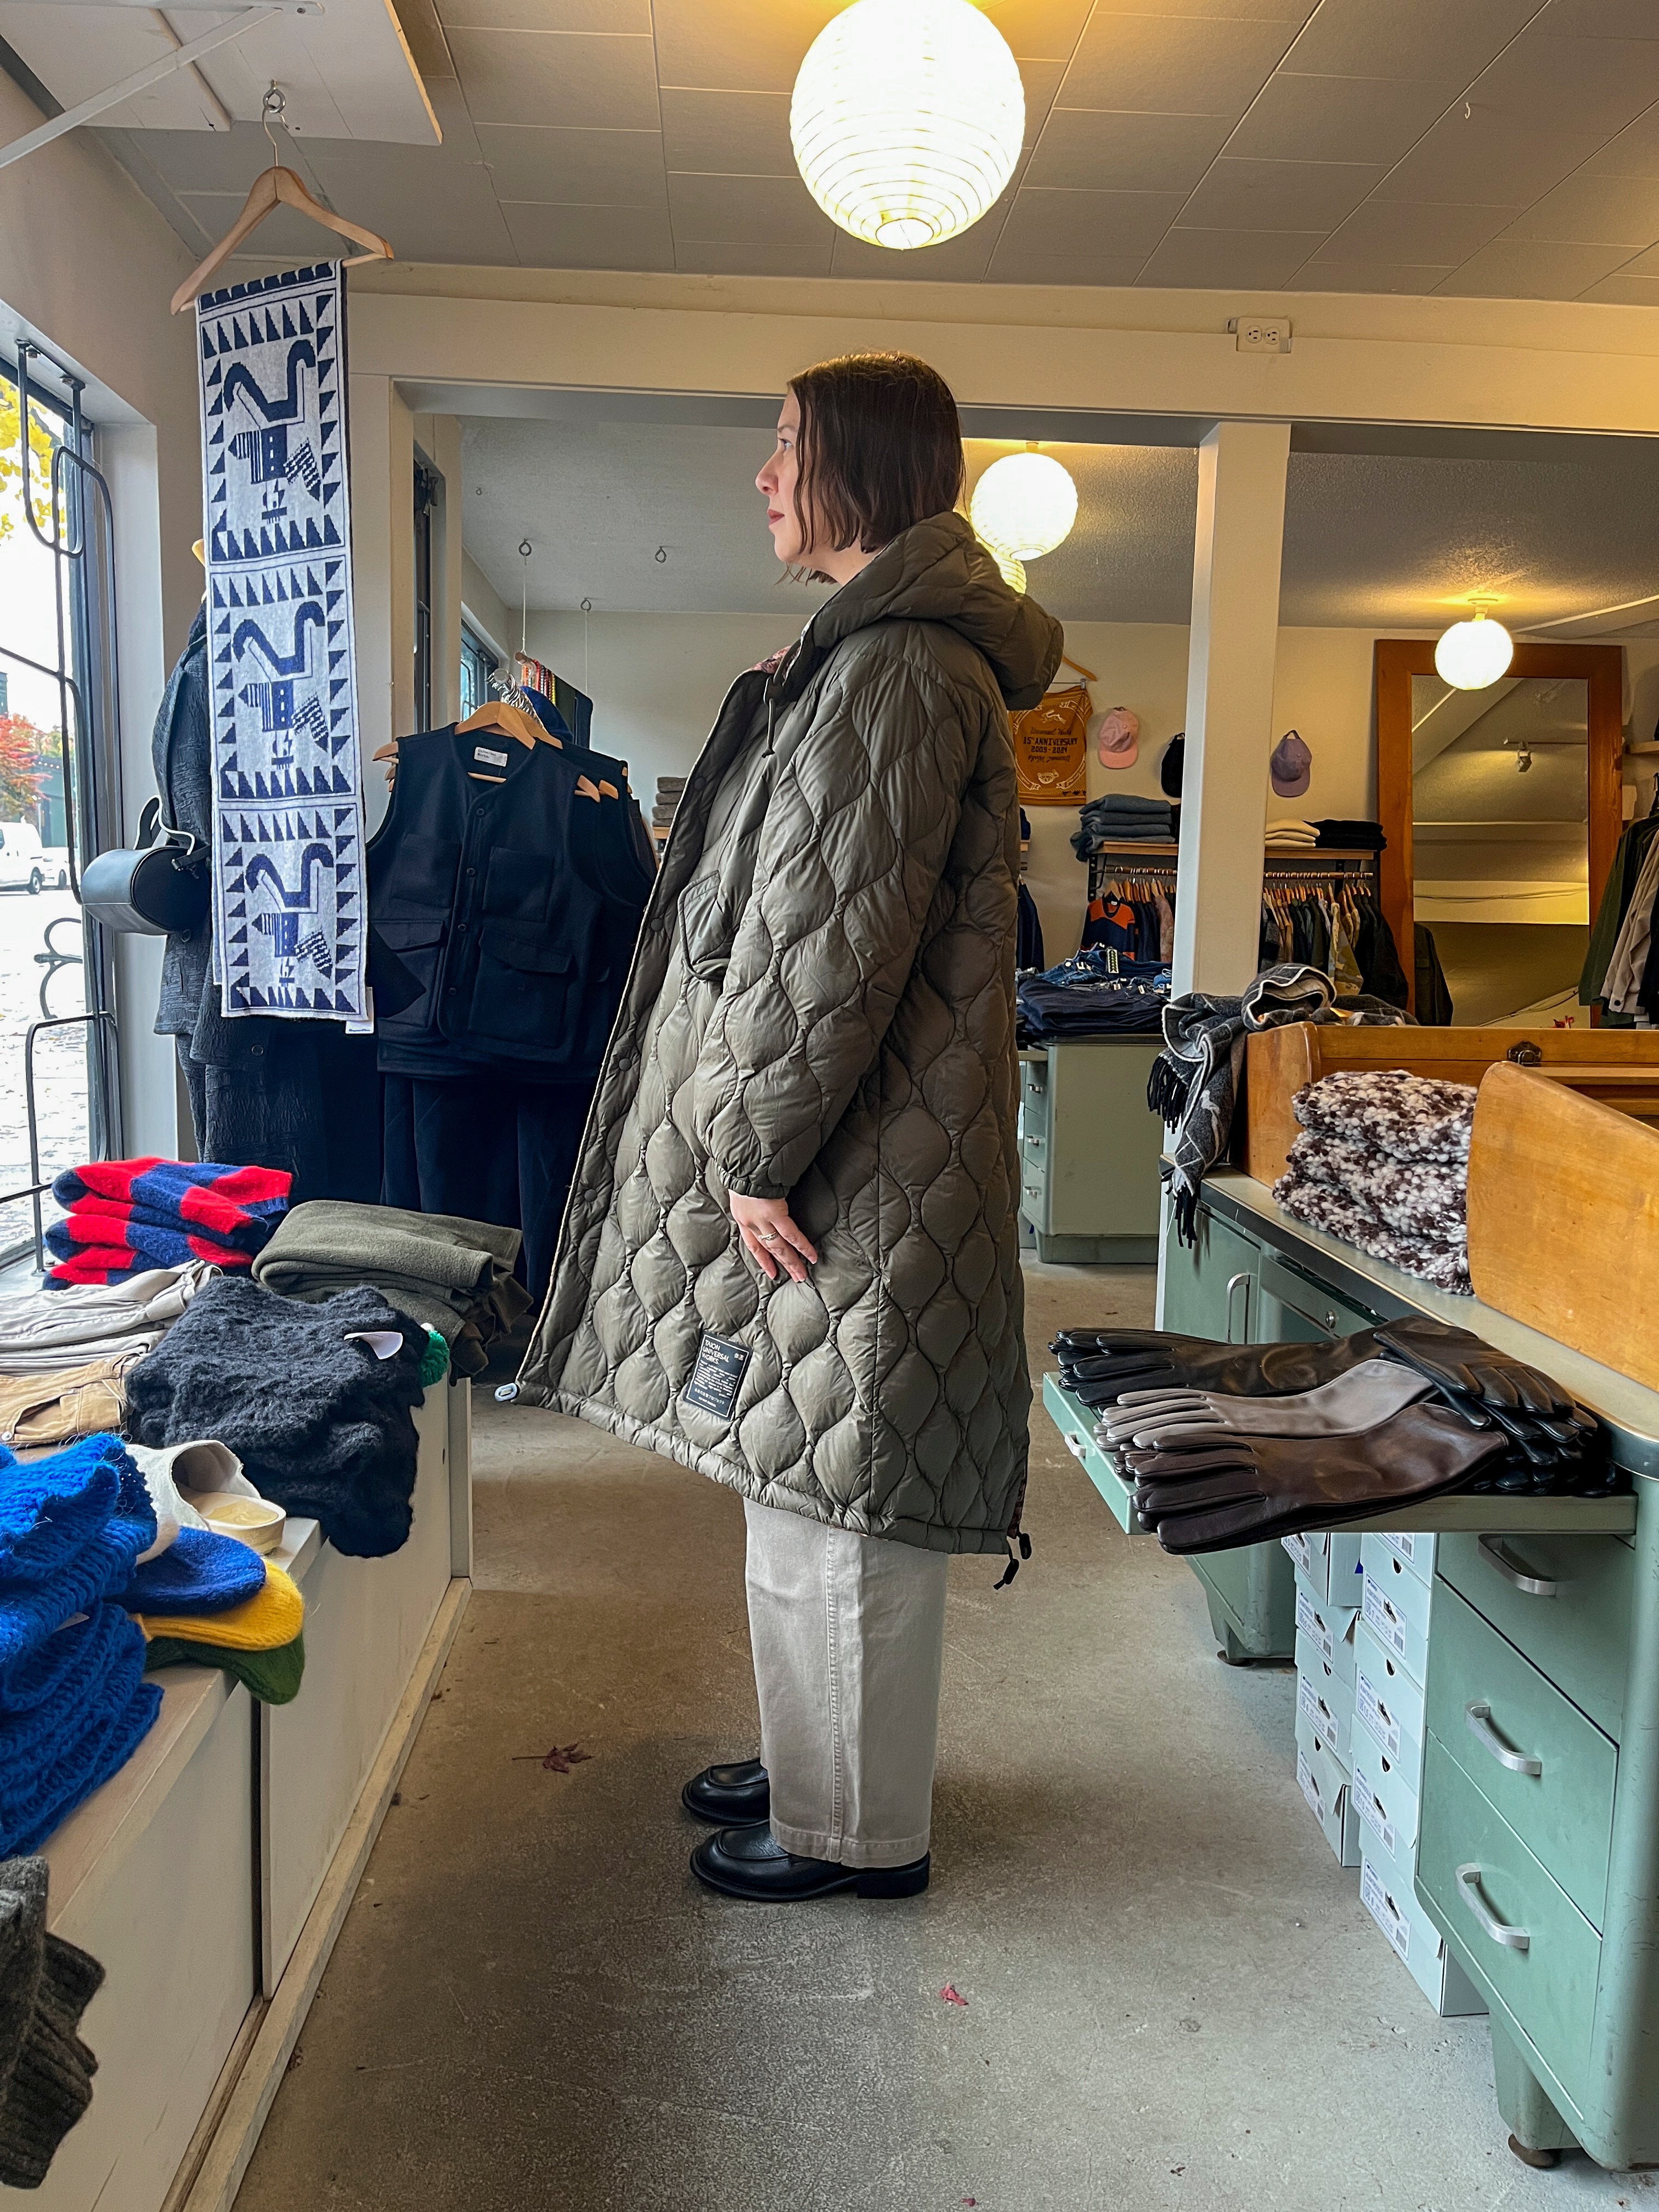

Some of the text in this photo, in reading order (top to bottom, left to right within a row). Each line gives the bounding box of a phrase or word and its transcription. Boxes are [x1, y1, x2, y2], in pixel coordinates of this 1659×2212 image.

[1035, 737, 1078, 746] ANNIVERSARY
[705, 1339, 721, 1351] TAION
[703, 1346, 729, 1363] UNIVERSAL
